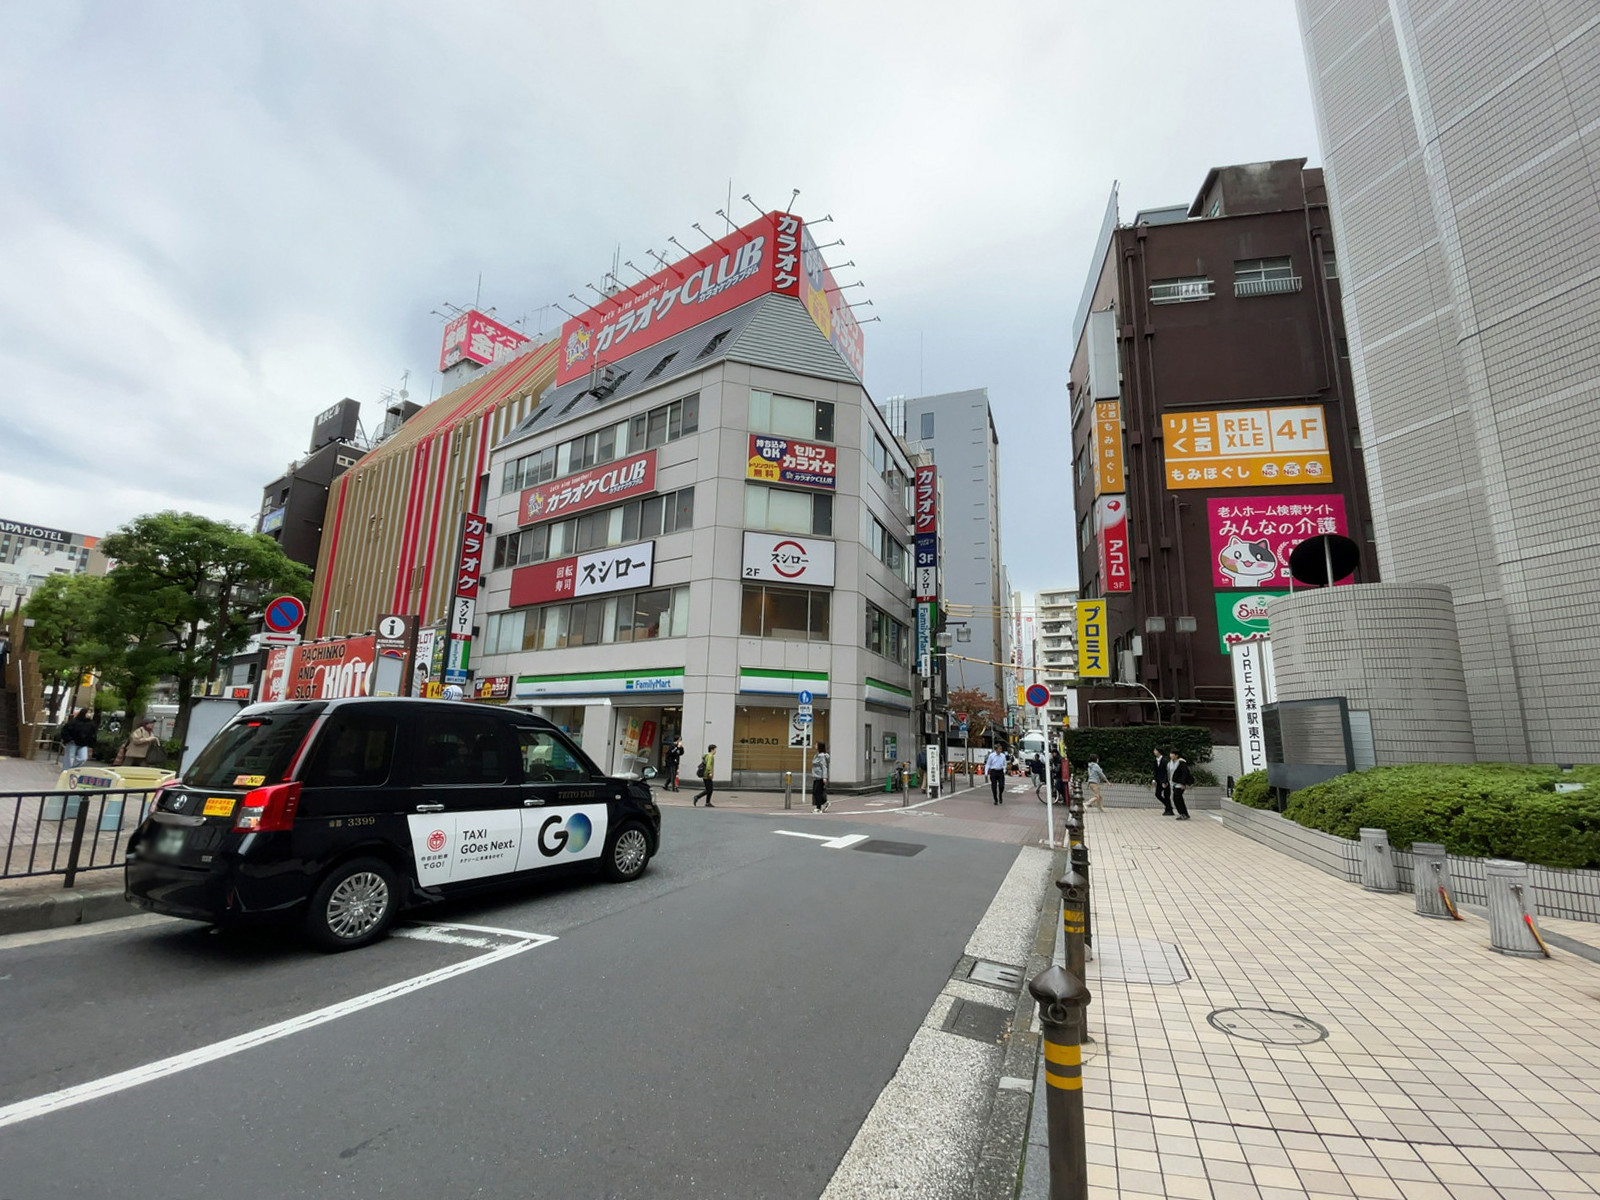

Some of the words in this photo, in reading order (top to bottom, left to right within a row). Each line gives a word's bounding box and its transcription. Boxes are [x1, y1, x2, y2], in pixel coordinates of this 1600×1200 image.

[774, 215, 798, 290] カラオケ
[1170, 417, 1211, 434] りら
[1224, 417, 1263, 433] REL
[1275, 417, 1319, 441] 4F
[755, 439, 787, 450] 持ち込み
[1171, 436, 1213, 454] くる
[1226, 432, 1265, 449] XLE
[762, 447, 781, 459] OK
[793, 444, 826, 459] セルフ
[1103, 423, 1116, 484] もみほぐし
[782, 454, 835, 474] カラオケ
[1170, 465, 1251, 481] もみほぐし
[917, 469, 935, 529] カラオケ
[1217, 503, 1335, 518] 老人ホーム検索サイト
[22, 526, 65, 542] HOTEL
[1218, 517, 1338, 536] みんなの介護
[458, 519, 484, 591] カラオケ
[770, 552, 809, 564] スシロー
[918, 552, 934, 564] 3F
[1109, 539, 1126, 577] アコム
[556, 564, 573, 579] 回転
[579, 557, 646, 588] スシロー
[745, 567, 761, 577] 2F
[554, 578, 571, 593] 寿司
[922, 568, 930, 595] スシロー
[1112, 581, 1125, 589] 3F
[458, 599, 471, 633] スシロー
[918, 606, 929, 656] FamilyMart
[1084, 606, 1102, 670] プロミス
[301, 644, 346, 663] PACHINKO
[297, 665, 316, 680] AND
[295, 685, 317, 699] SLOT
[635, 679, 671, 690] FamilyMart
[750, 737, 779, 745] 店内入口
[347, 816, 375, 827] 3399
[463, 829, 487, 841] TAXI
[537, 812, 592, 858] GO
[460, 842, 489, 855] GOes
[490, 839, 515, 852] Next.
[423, 860, 445, 870] でGO!
